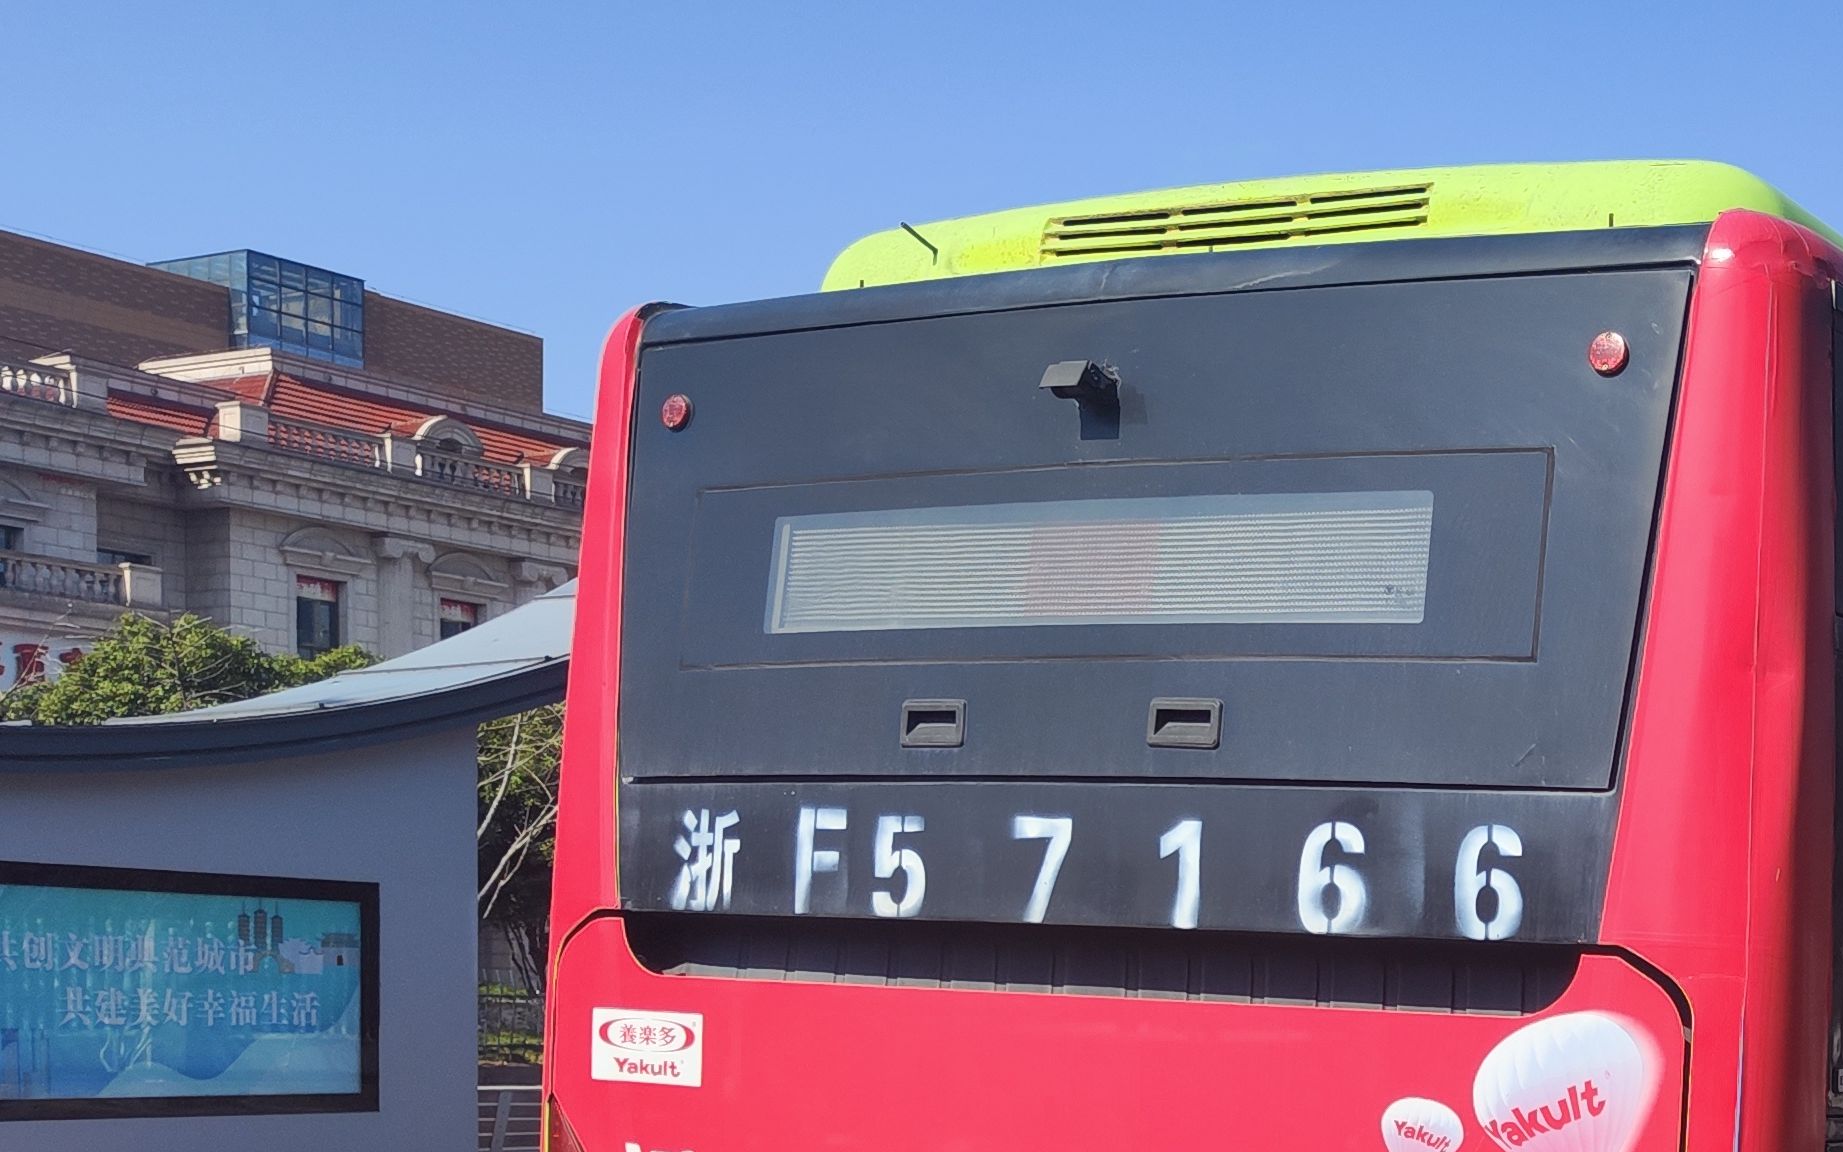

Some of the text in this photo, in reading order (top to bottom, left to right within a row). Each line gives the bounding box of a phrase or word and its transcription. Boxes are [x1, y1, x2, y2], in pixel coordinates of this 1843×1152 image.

[673, 808, 740, 911] 浙
[58, 986, 320, 1027] 共建美好幸福生活
[613, 1056, 681, 1078] Yakult
[1484, 1080, 1606, 1150] Yakult
